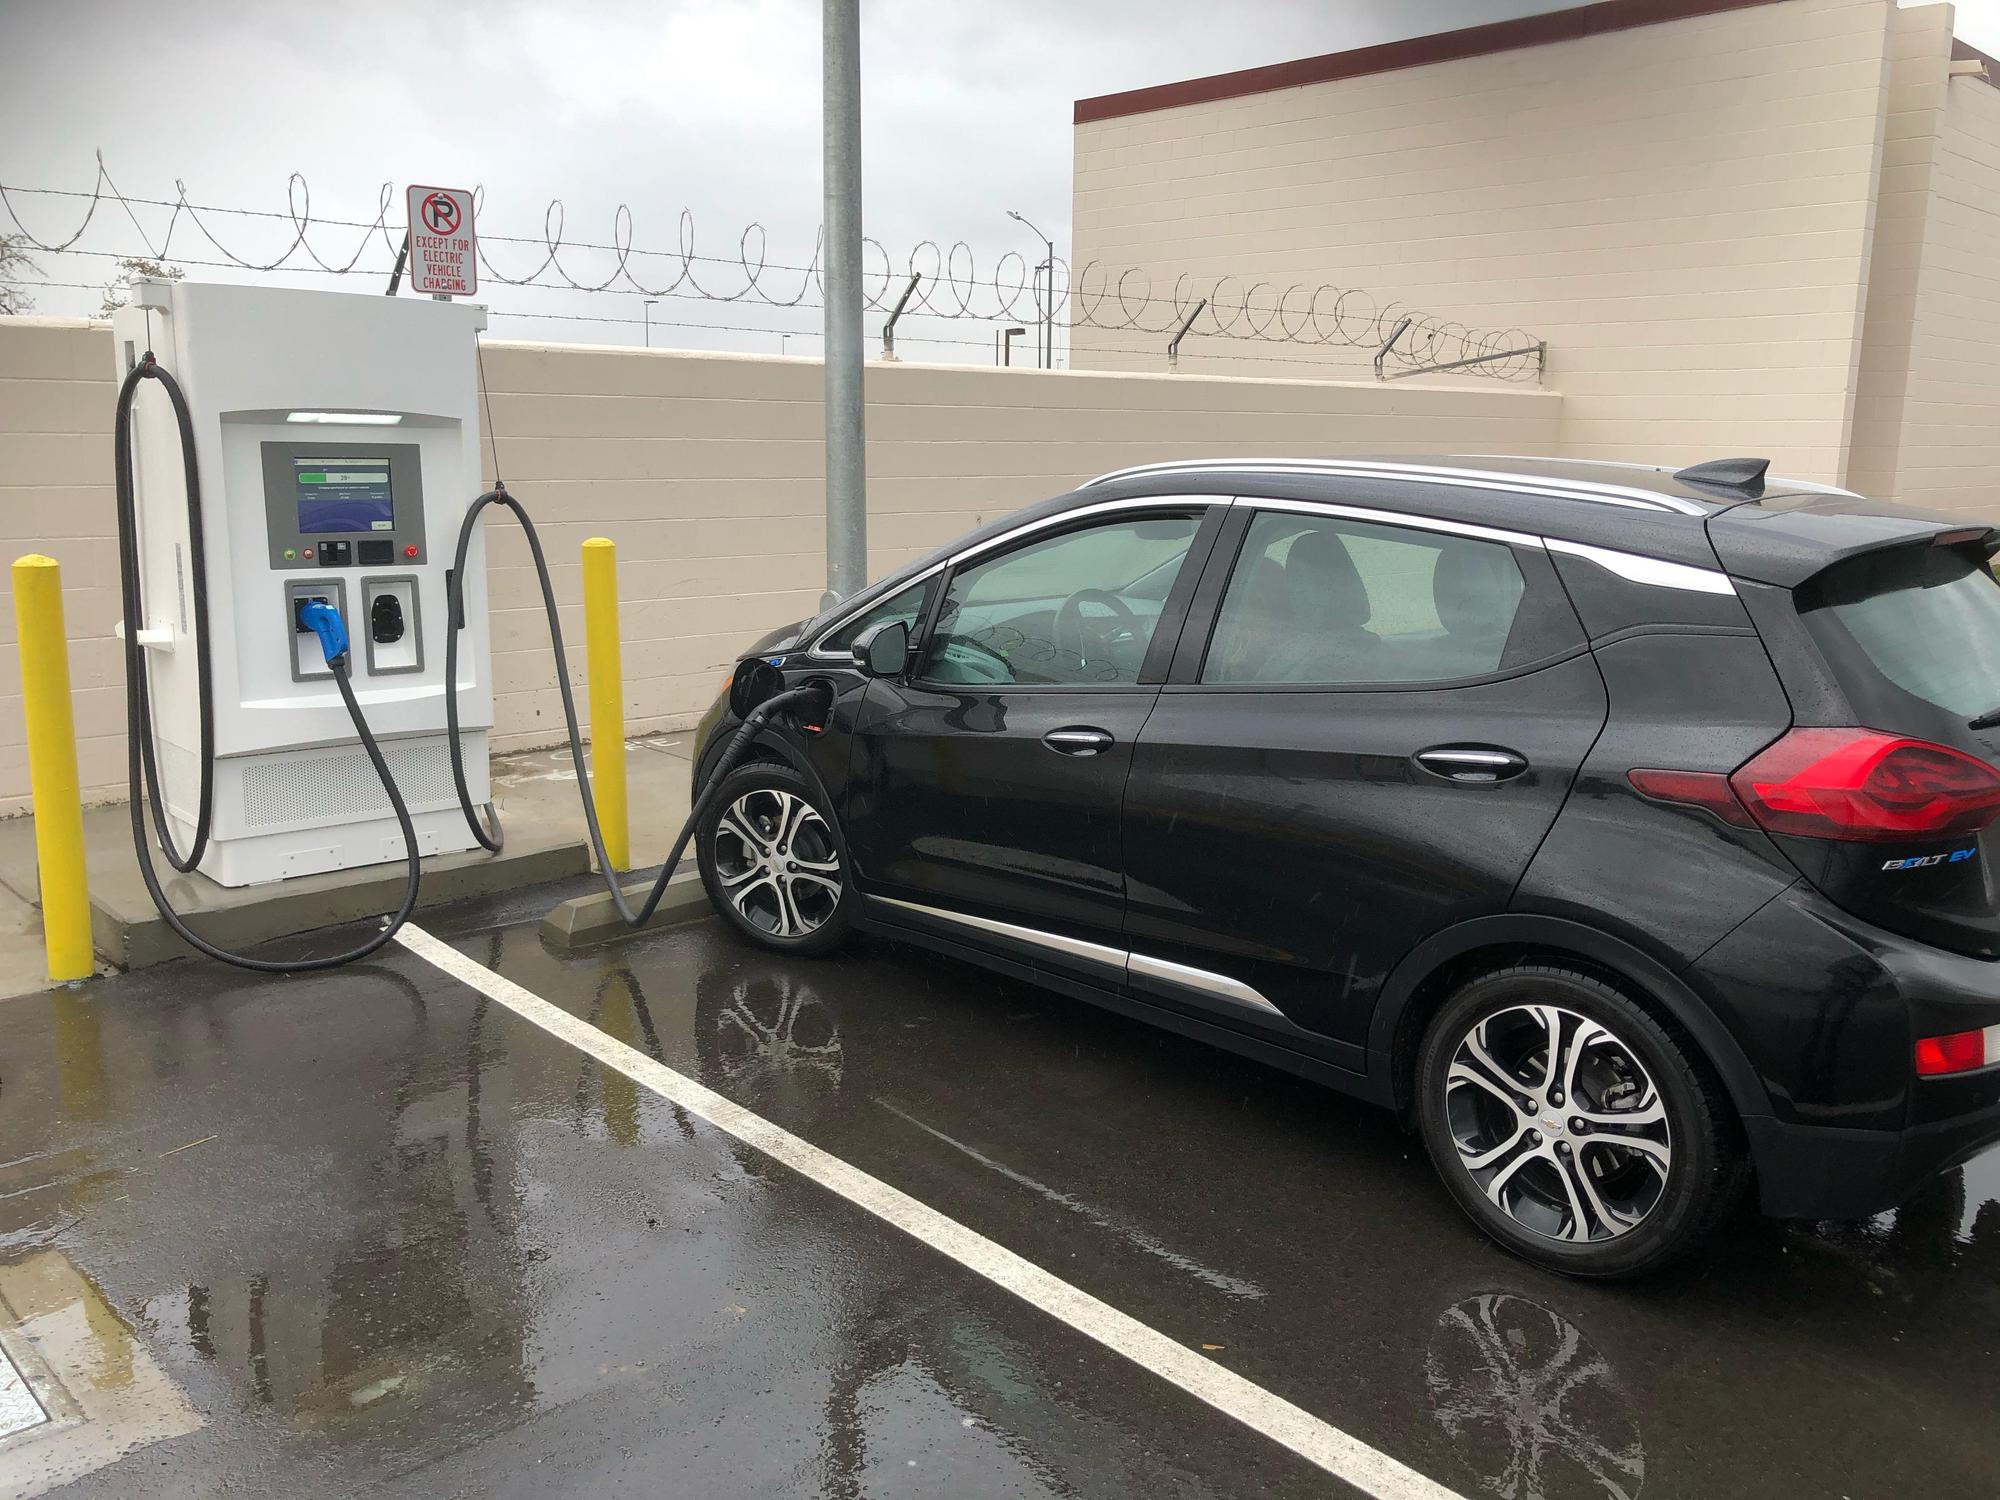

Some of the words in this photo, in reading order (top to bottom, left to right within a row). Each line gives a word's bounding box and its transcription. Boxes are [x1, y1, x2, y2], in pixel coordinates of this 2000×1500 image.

[416, 236, 449, 250] EXCEPT
[452, 239, 469, 252] FOR
[423, 250, 464, 264] ELECTRIC
[426, 264, 462, 278] VEHICLE
[1949, 847, 1976, 863] EV
